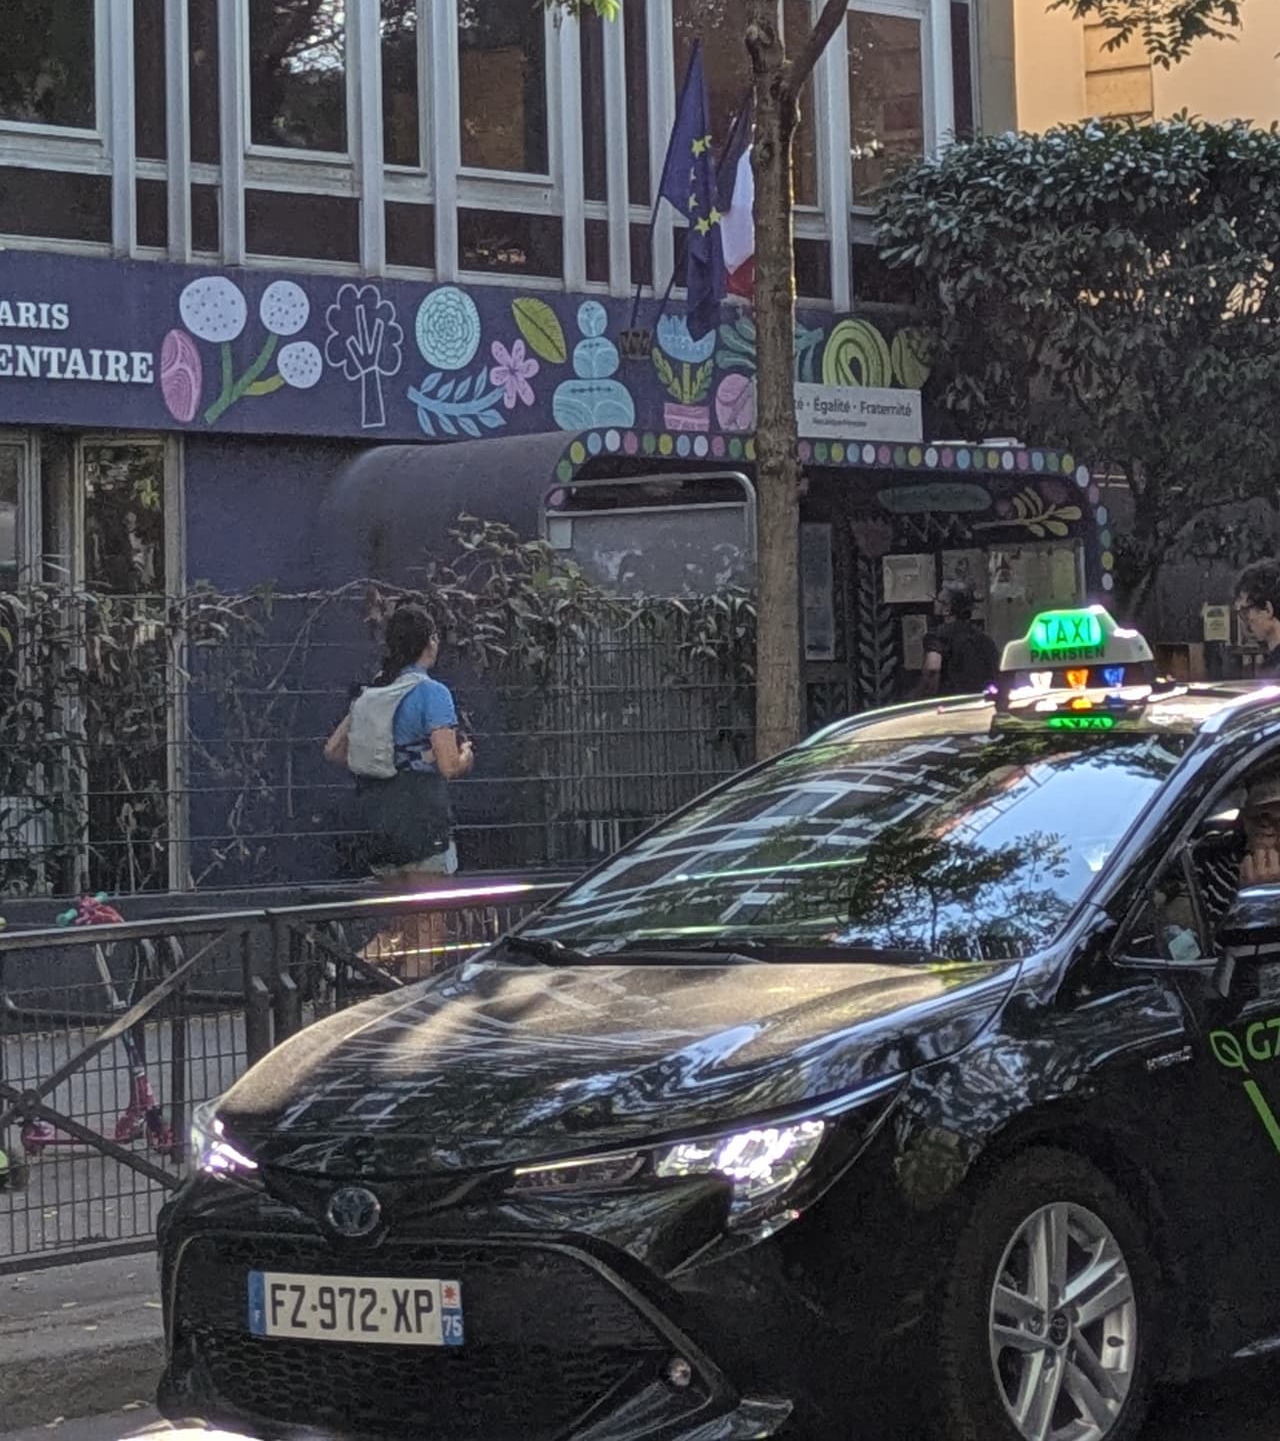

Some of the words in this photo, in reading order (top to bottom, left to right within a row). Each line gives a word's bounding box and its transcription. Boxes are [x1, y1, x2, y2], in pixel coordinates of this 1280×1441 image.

[813, 396, 851, 415] Égalité
[860, 400, 913, 418] Fraternité
[1039, 617, 1093, 645] TAXI
[1030, 645, 1105, 663] PARISIEN
[270, 1283, 434, 1334] FZ-972-XP
[442, 1315, 463, 1337] 75
